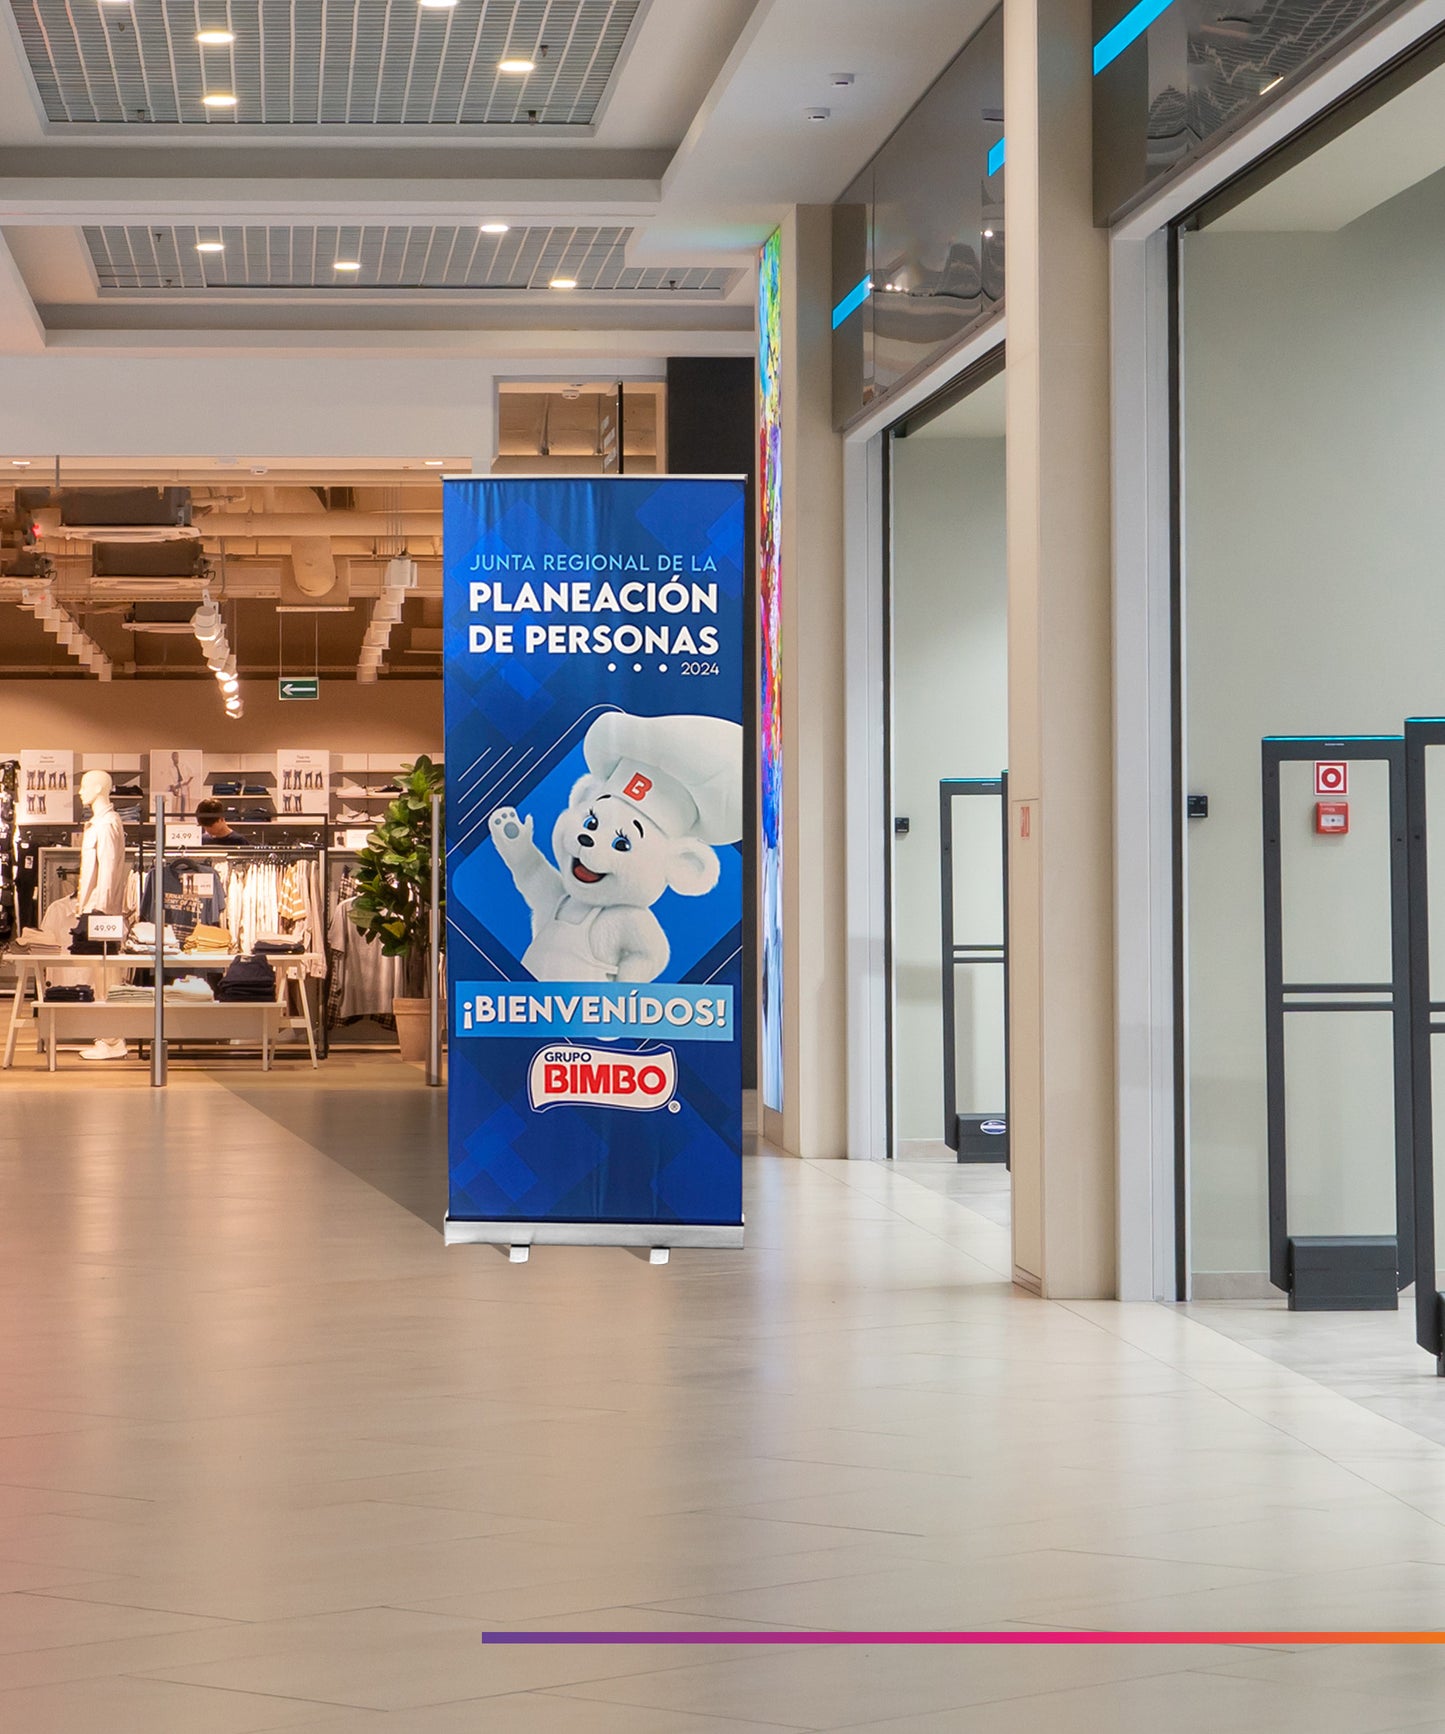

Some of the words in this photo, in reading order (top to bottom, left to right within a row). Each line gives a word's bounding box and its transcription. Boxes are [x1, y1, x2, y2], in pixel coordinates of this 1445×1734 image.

[470, 554, 536, 571] JUNTA
[543, 554, 650, 571] REGIONAL
[658, 555, 683, 571] DE
[691, 555, 717, 572] LA
[469, 575, 718, 614] PLANEACIÓN
[469, 625, 514, 654] DE
[525, 625, 719, 655] PERSONAS
[680, 661, 720, 676] 2024
[623, 772, 653, 801] B
[171, 832, 192, 840] 24.99
[463, 989, 728, 1030] ¡BIENVENÍDOS!
[544, 1051, 592, 1064] GRUPO
[544, 1064, 667, 1095] BIMBO
